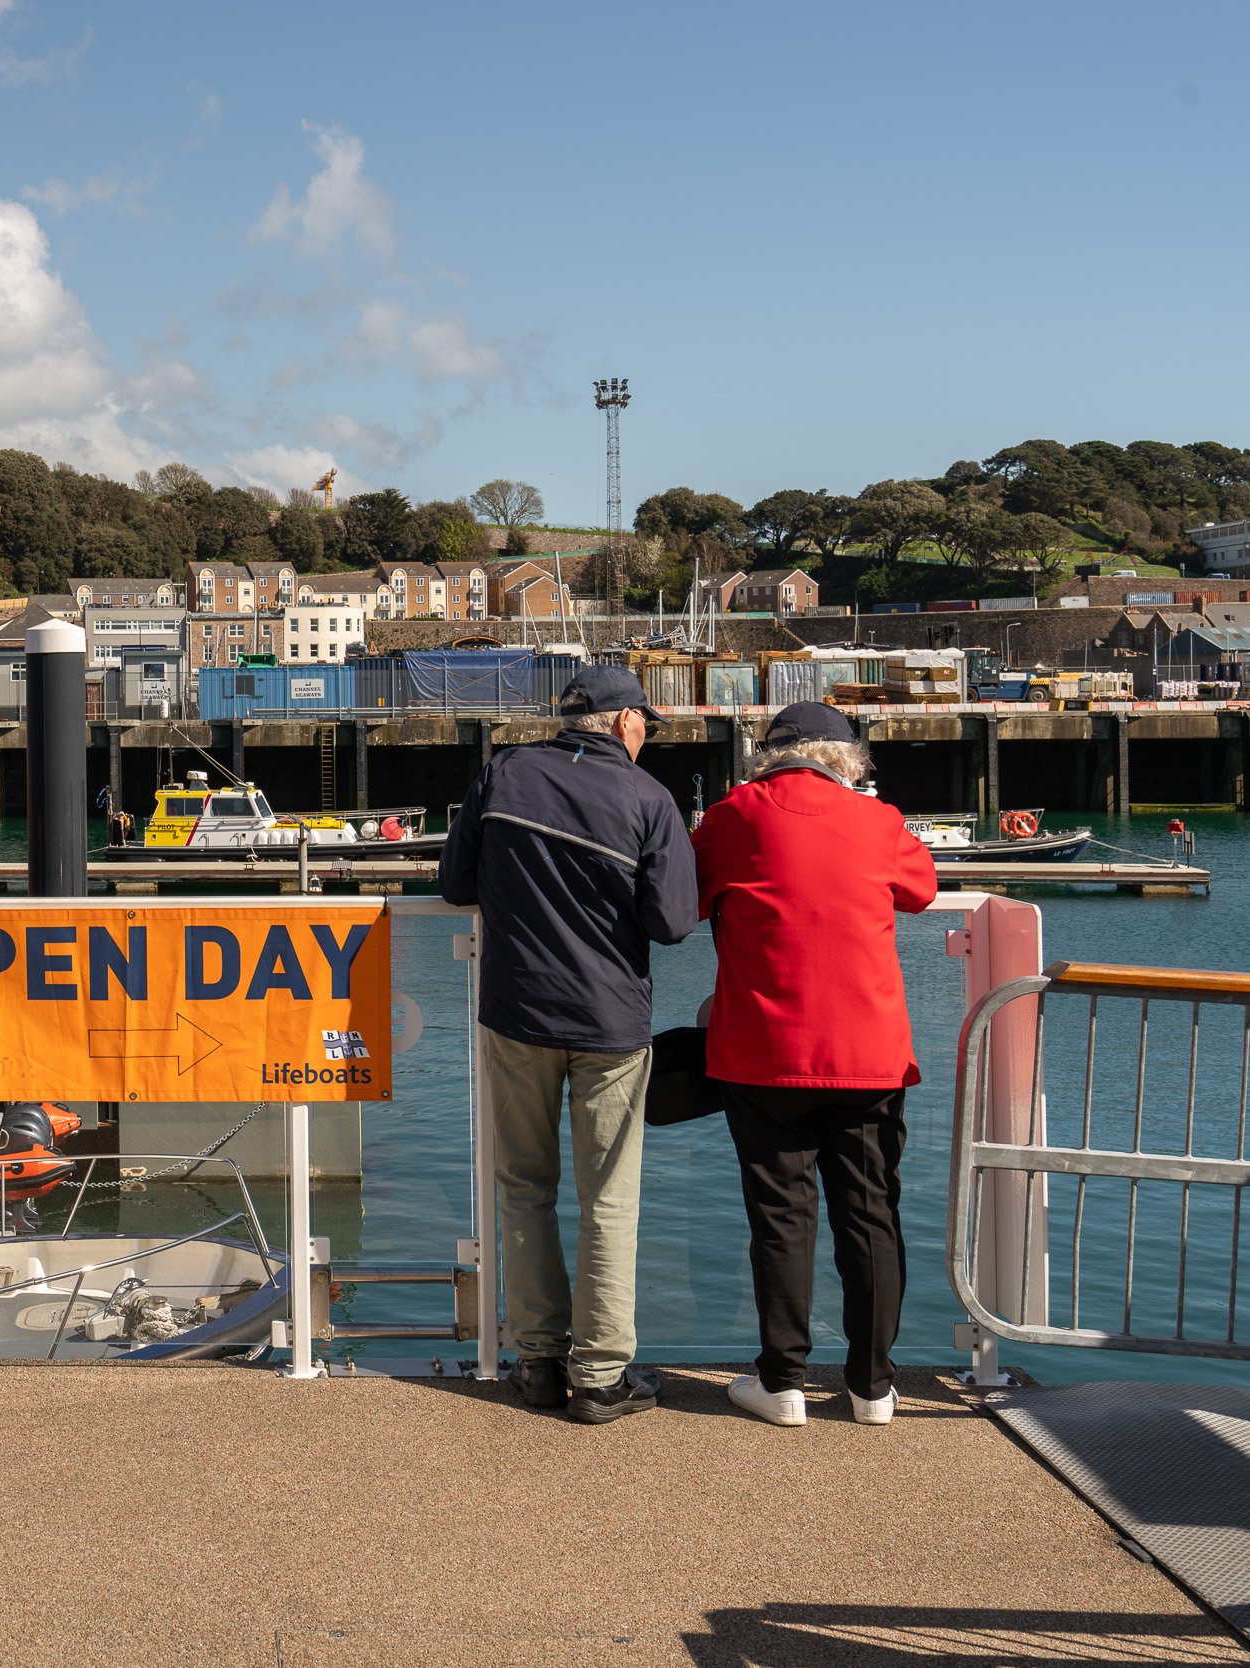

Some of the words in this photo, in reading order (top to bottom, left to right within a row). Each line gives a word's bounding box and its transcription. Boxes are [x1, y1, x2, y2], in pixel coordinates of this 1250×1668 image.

[906, 823, 931, 832] RVEY
[184, 924, 372, 1000] DAY
[262, 1063, 372, 1084] Lifeboats
